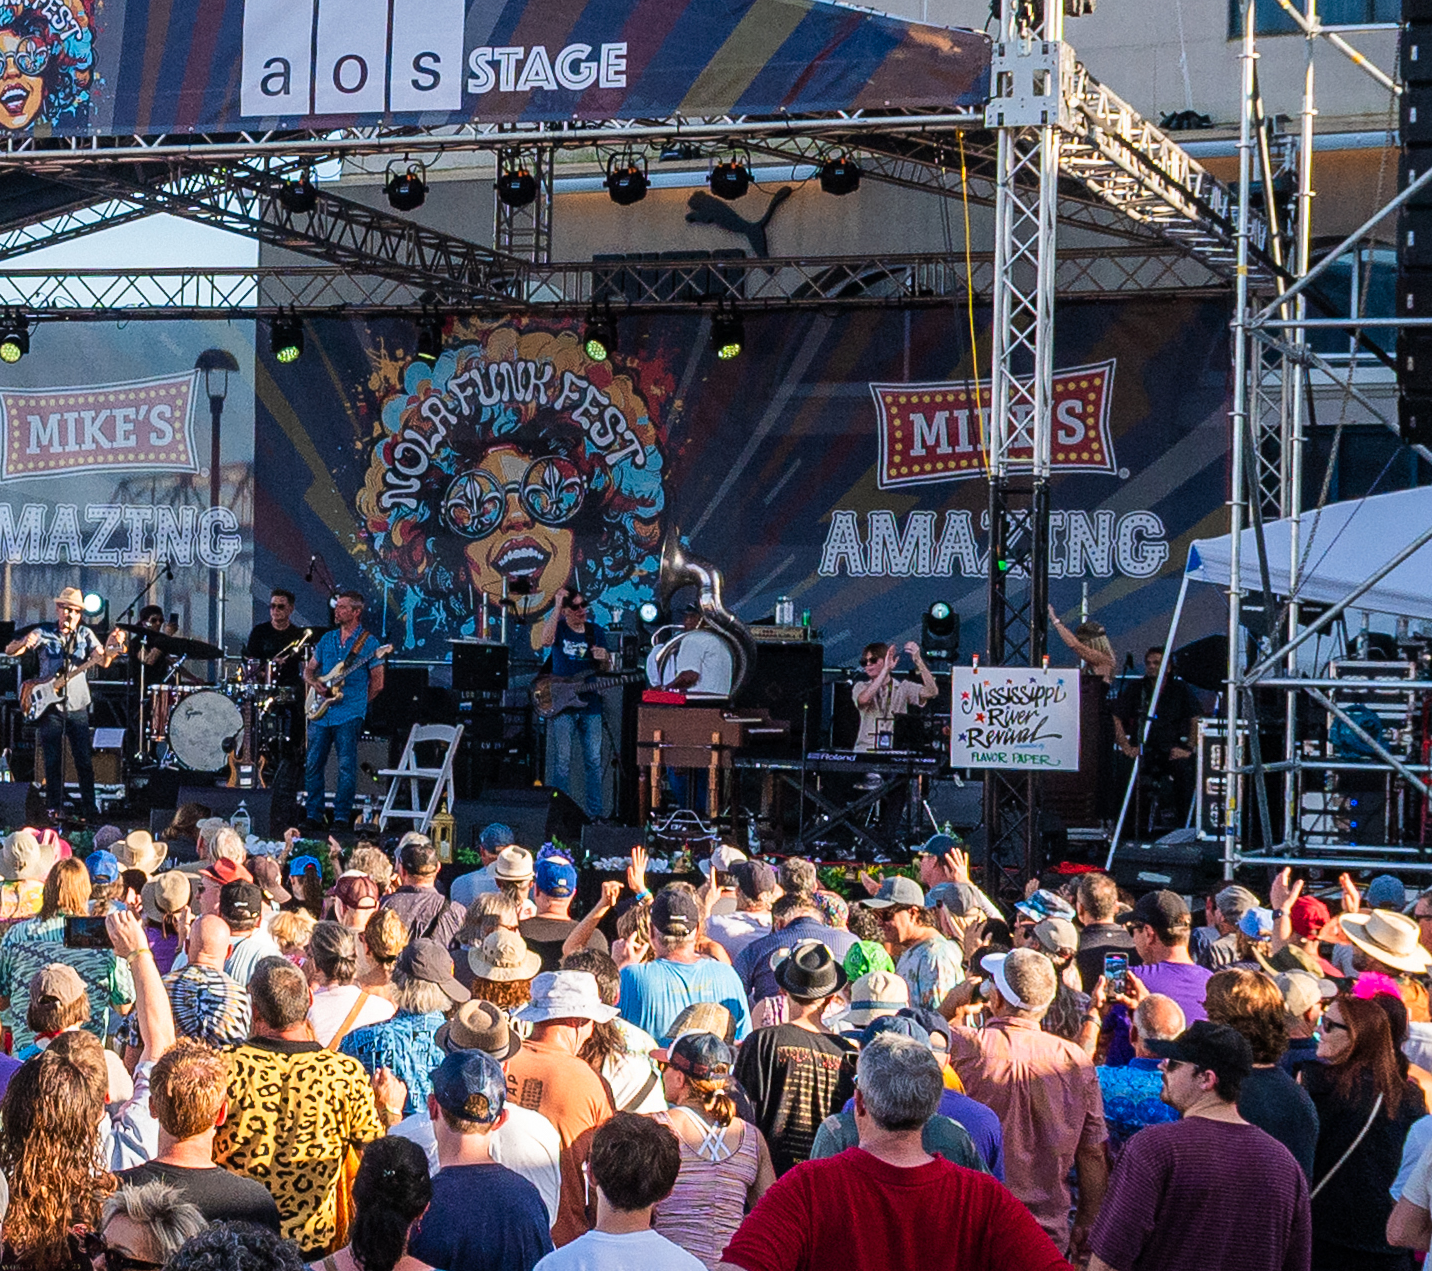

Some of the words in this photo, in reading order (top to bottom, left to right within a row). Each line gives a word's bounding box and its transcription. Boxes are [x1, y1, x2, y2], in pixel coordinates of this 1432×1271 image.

[259, 48, 442, 98] aos
[467, 42, 629, 95] STAGE
[25, 400, 174, 456] MIKE'S
[382, 396, 458, 508] NOLA
[447, 361, 552, 416] FUNK
[554, 372, 646, 466] FEST
[966, 716, 1062, 749] Revival
[987, 707, 1039, 728] River
[971, 752, 1007, 763] FLAVOR
[1012, 753, 1061, 766] PAPER
